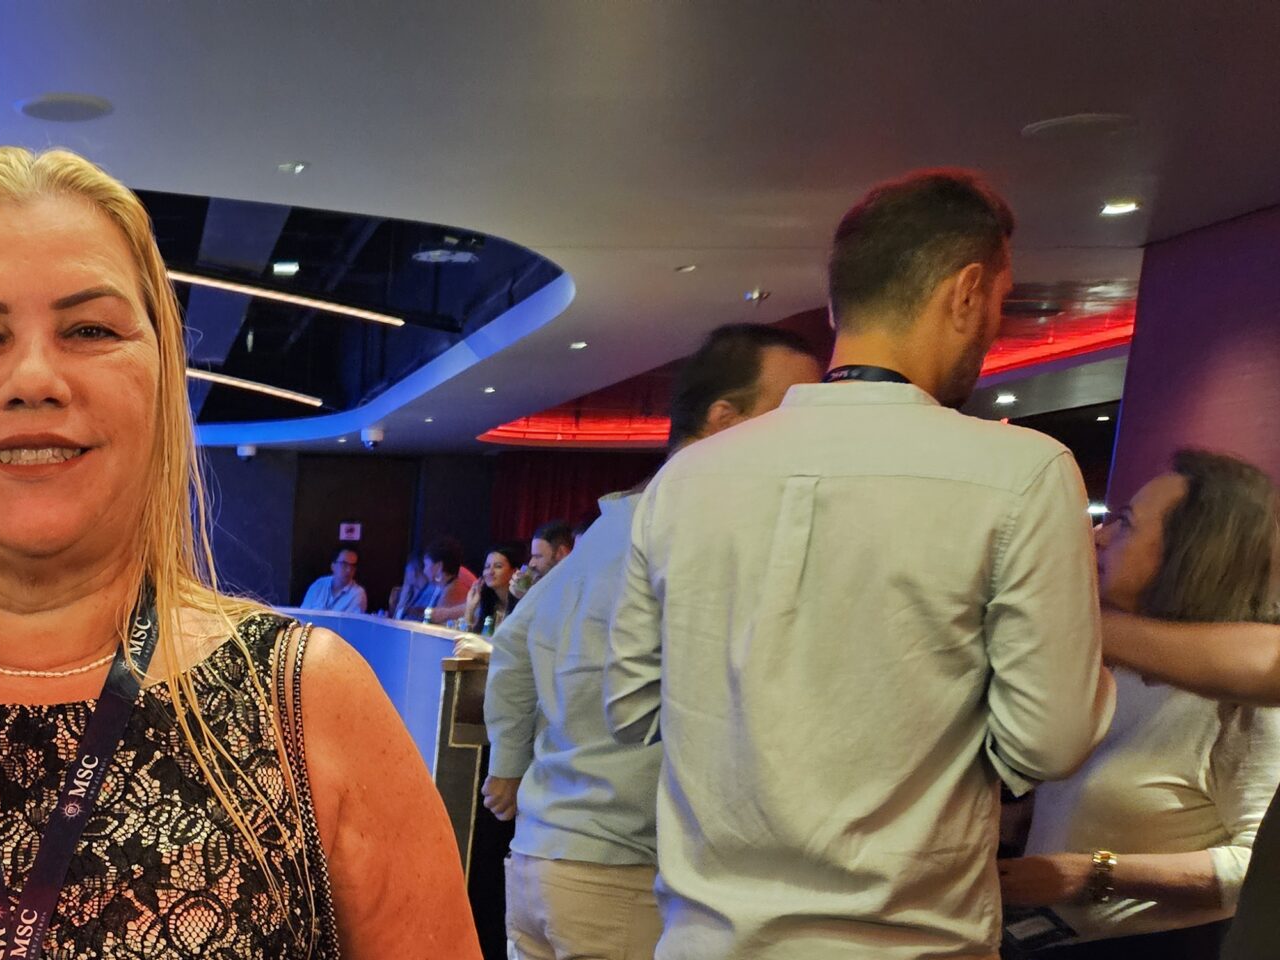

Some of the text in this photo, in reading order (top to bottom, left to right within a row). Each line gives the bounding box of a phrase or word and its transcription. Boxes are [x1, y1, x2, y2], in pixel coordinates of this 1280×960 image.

[128, 617, 152, 656] MSC
[68, 754, 99, 798] MSC
[10, 909, 38, 958] MSC
